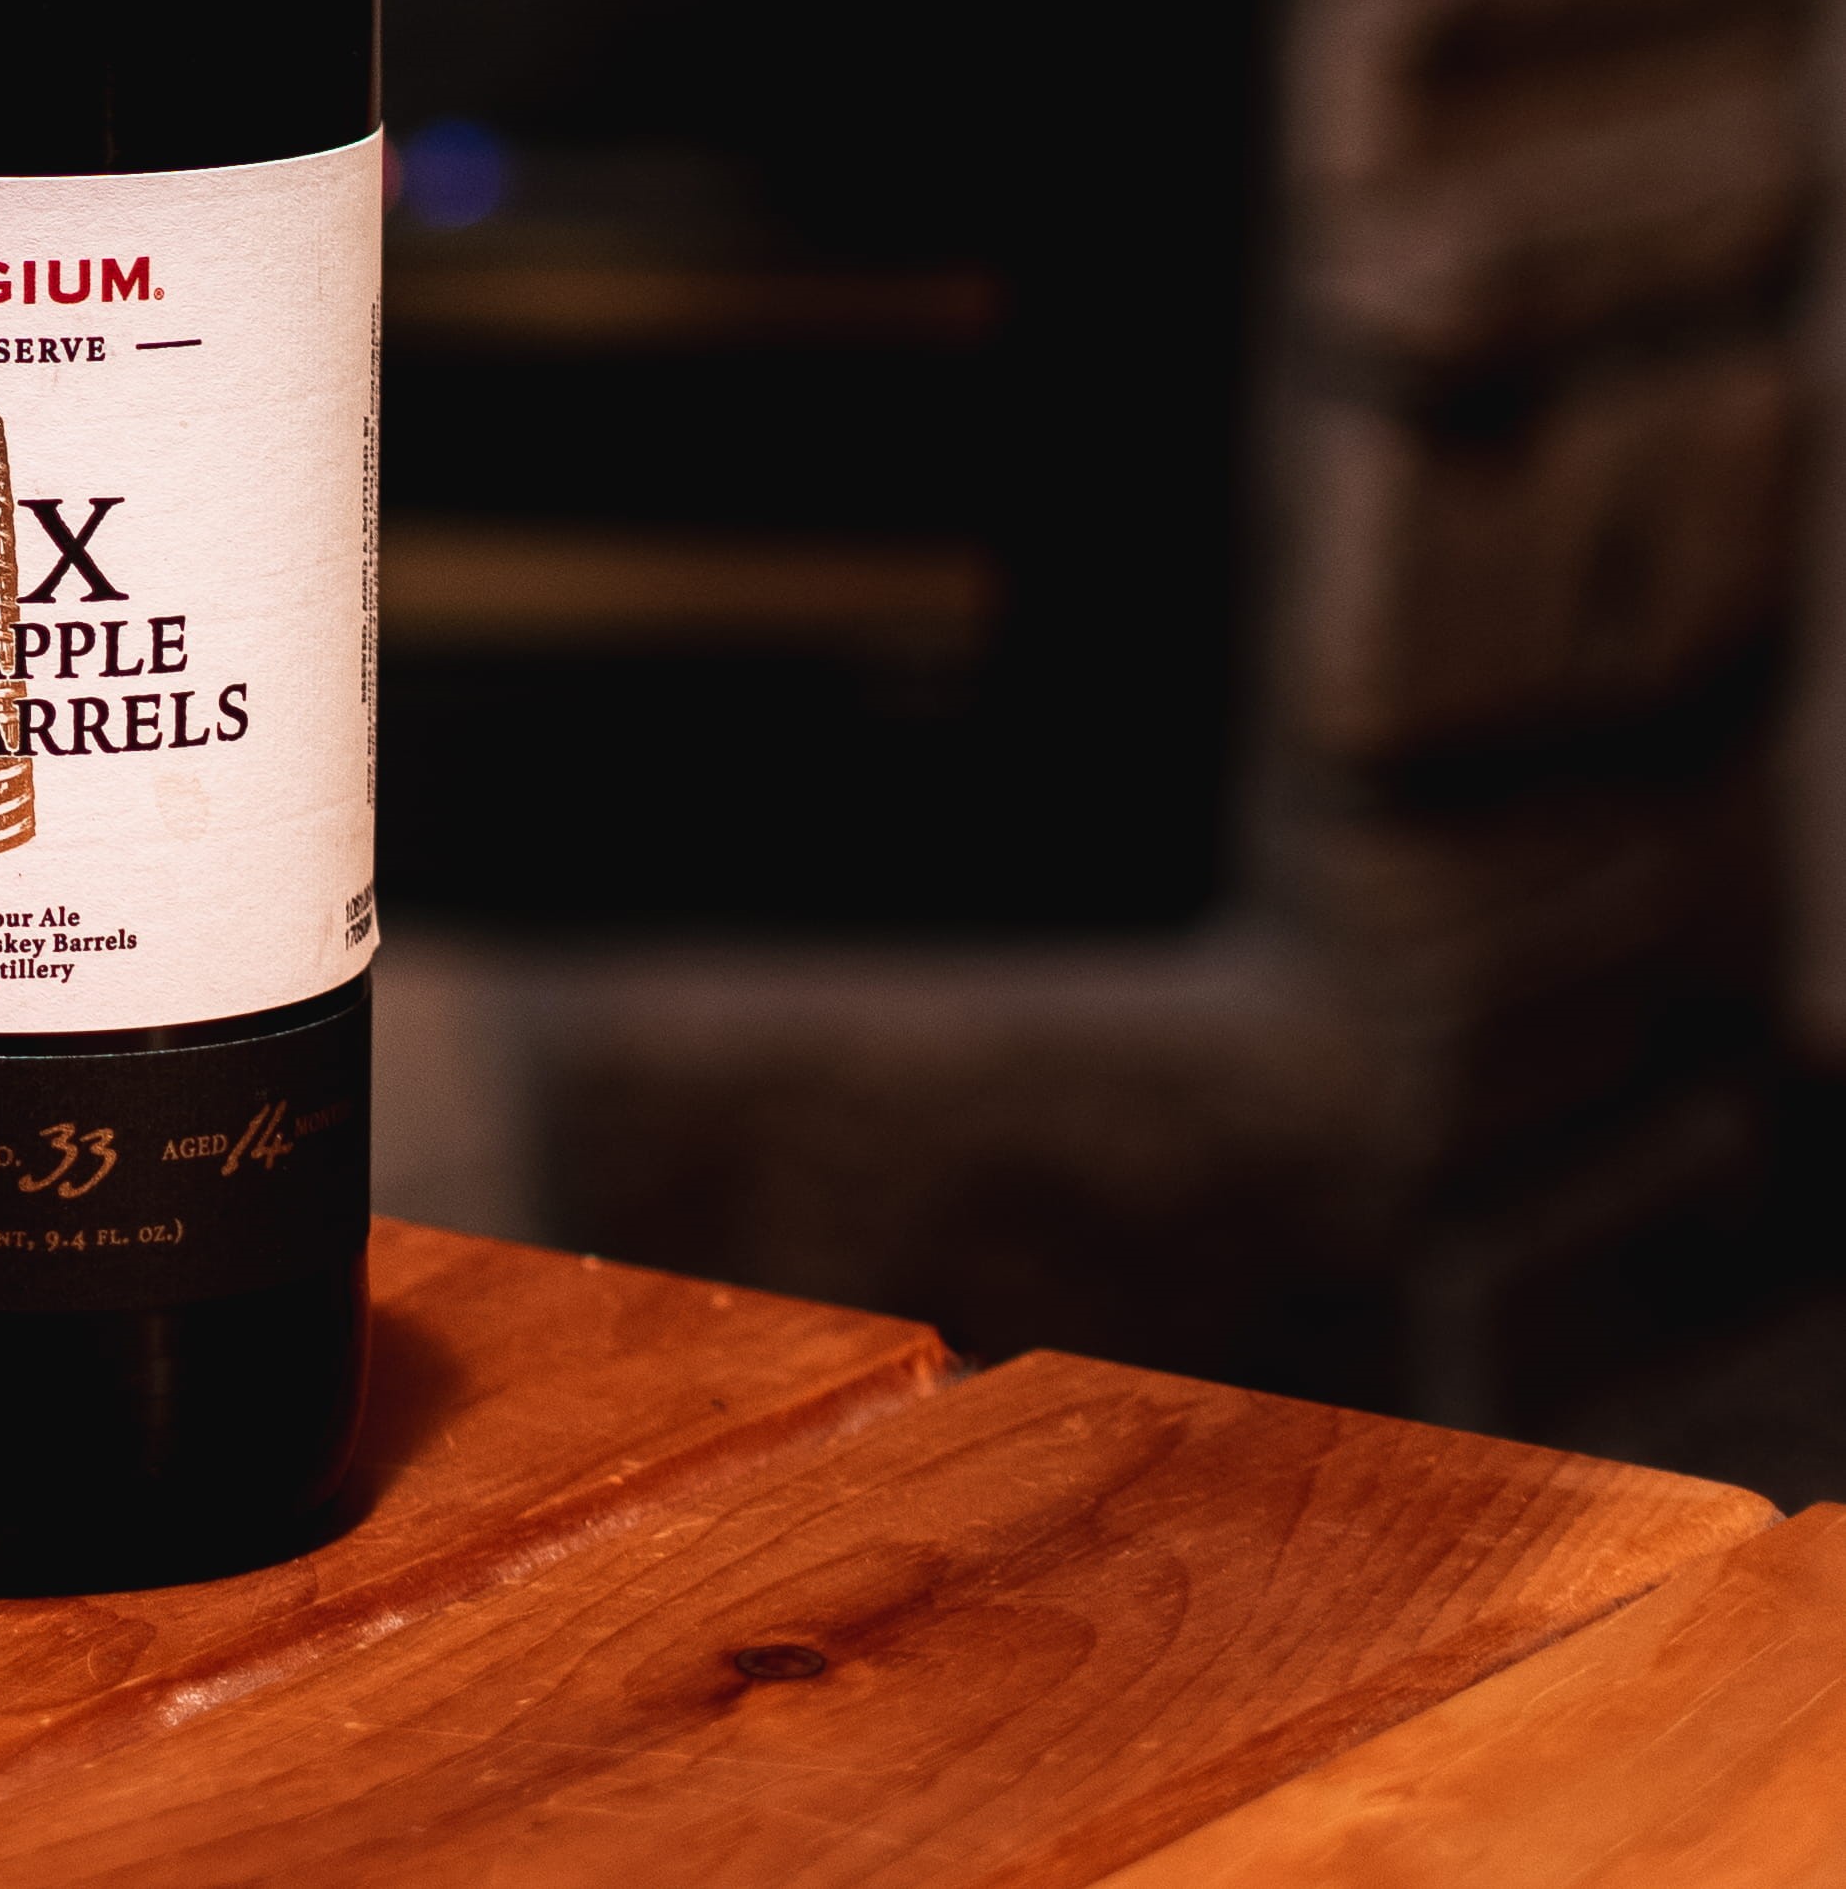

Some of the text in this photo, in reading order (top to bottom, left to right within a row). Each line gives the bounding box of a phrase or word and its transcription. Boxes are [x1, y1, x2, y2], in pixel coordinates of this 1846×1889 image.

[38, 905, 81, 927] Ale
[52, 928, 138, 953] Barrels
[17, 1121, 119, 1200] 33
[161, 1132, 229, 1163] AGED
[43, 1230, 89, 1253] 9.4
[95, 1229, 131, 1248] FL.
[138, 1216, 185, 1246] OZ.)
